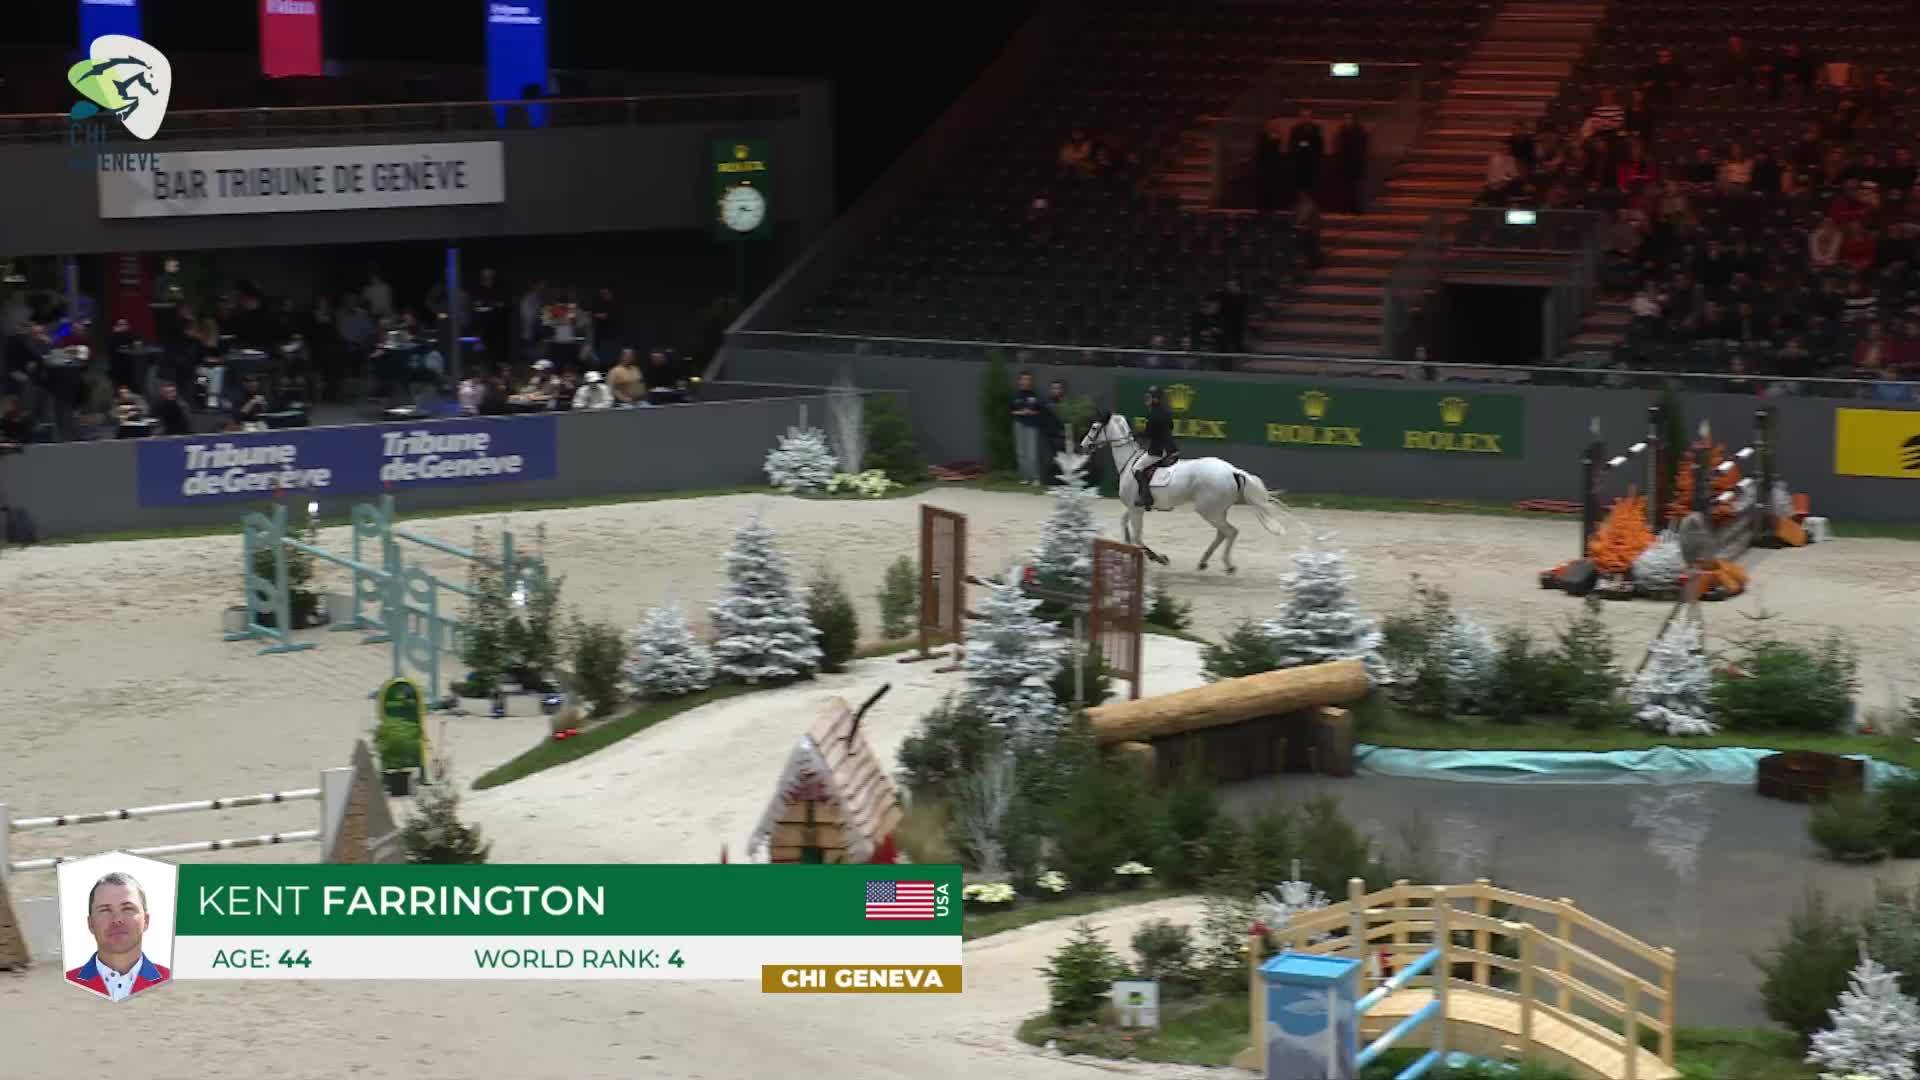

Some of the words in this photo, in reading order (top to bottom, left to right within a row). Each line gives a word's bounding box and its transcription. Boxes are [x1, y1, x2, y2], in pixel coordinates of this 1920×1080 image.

[153, 168, 207, 201] BAR
[216, 164, 325, 197] TRIBUNE
[334, 163, 365, 194] DE
[373, 154, 468, 193] GENÈVE
[1134, 415, 1228, 439] RLEX
[1266, 423, 1363, 447] ROLEX
[381, 430, 490, 457] Tribune
[1404, 430, 1502, 453] ROLEX
[183, 442, 298, 470] Tribune
[380, 452, 524, 482] deGenève
[181, 465, 333, 496] deGenève
